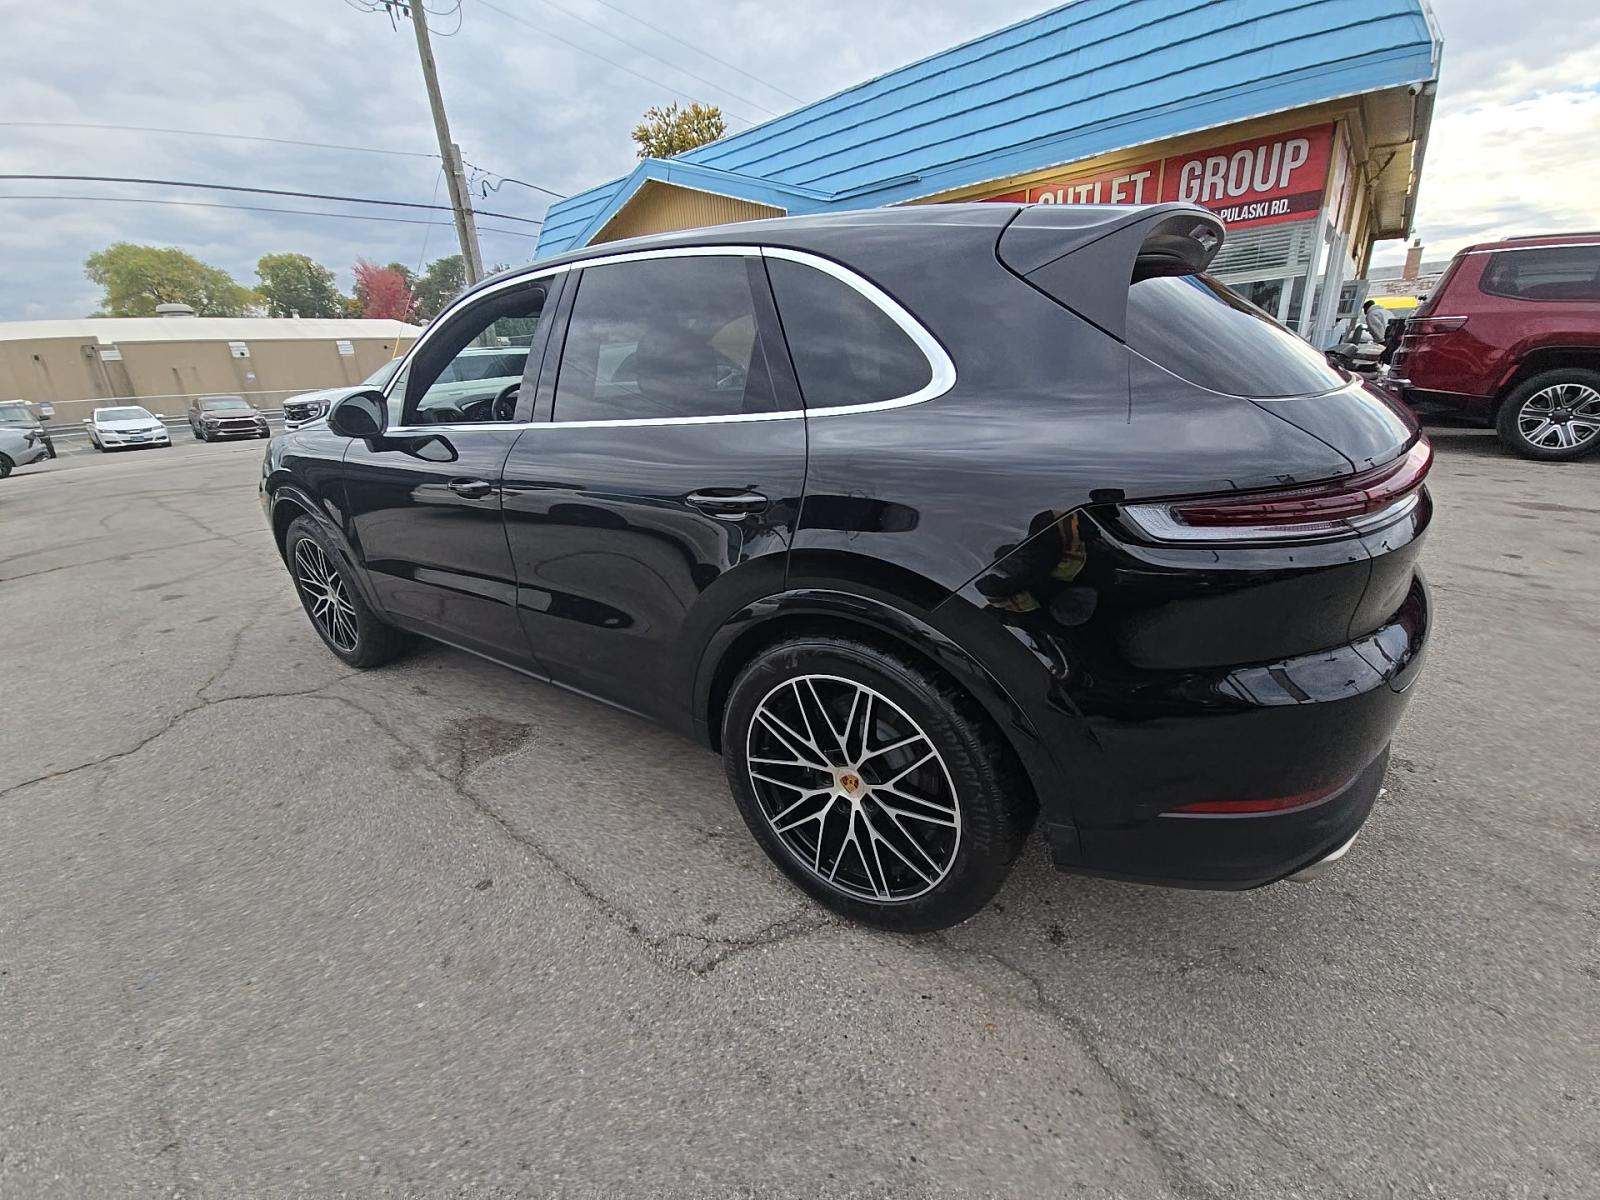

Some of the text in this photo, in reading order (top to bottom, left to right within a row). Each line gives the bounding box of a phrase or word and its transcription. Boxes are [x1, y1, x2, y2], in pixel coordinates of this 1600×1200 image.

[1179, 138, 1309, 203] GROUP
[1220, 199, 1291, 222] PULASKI RD.
